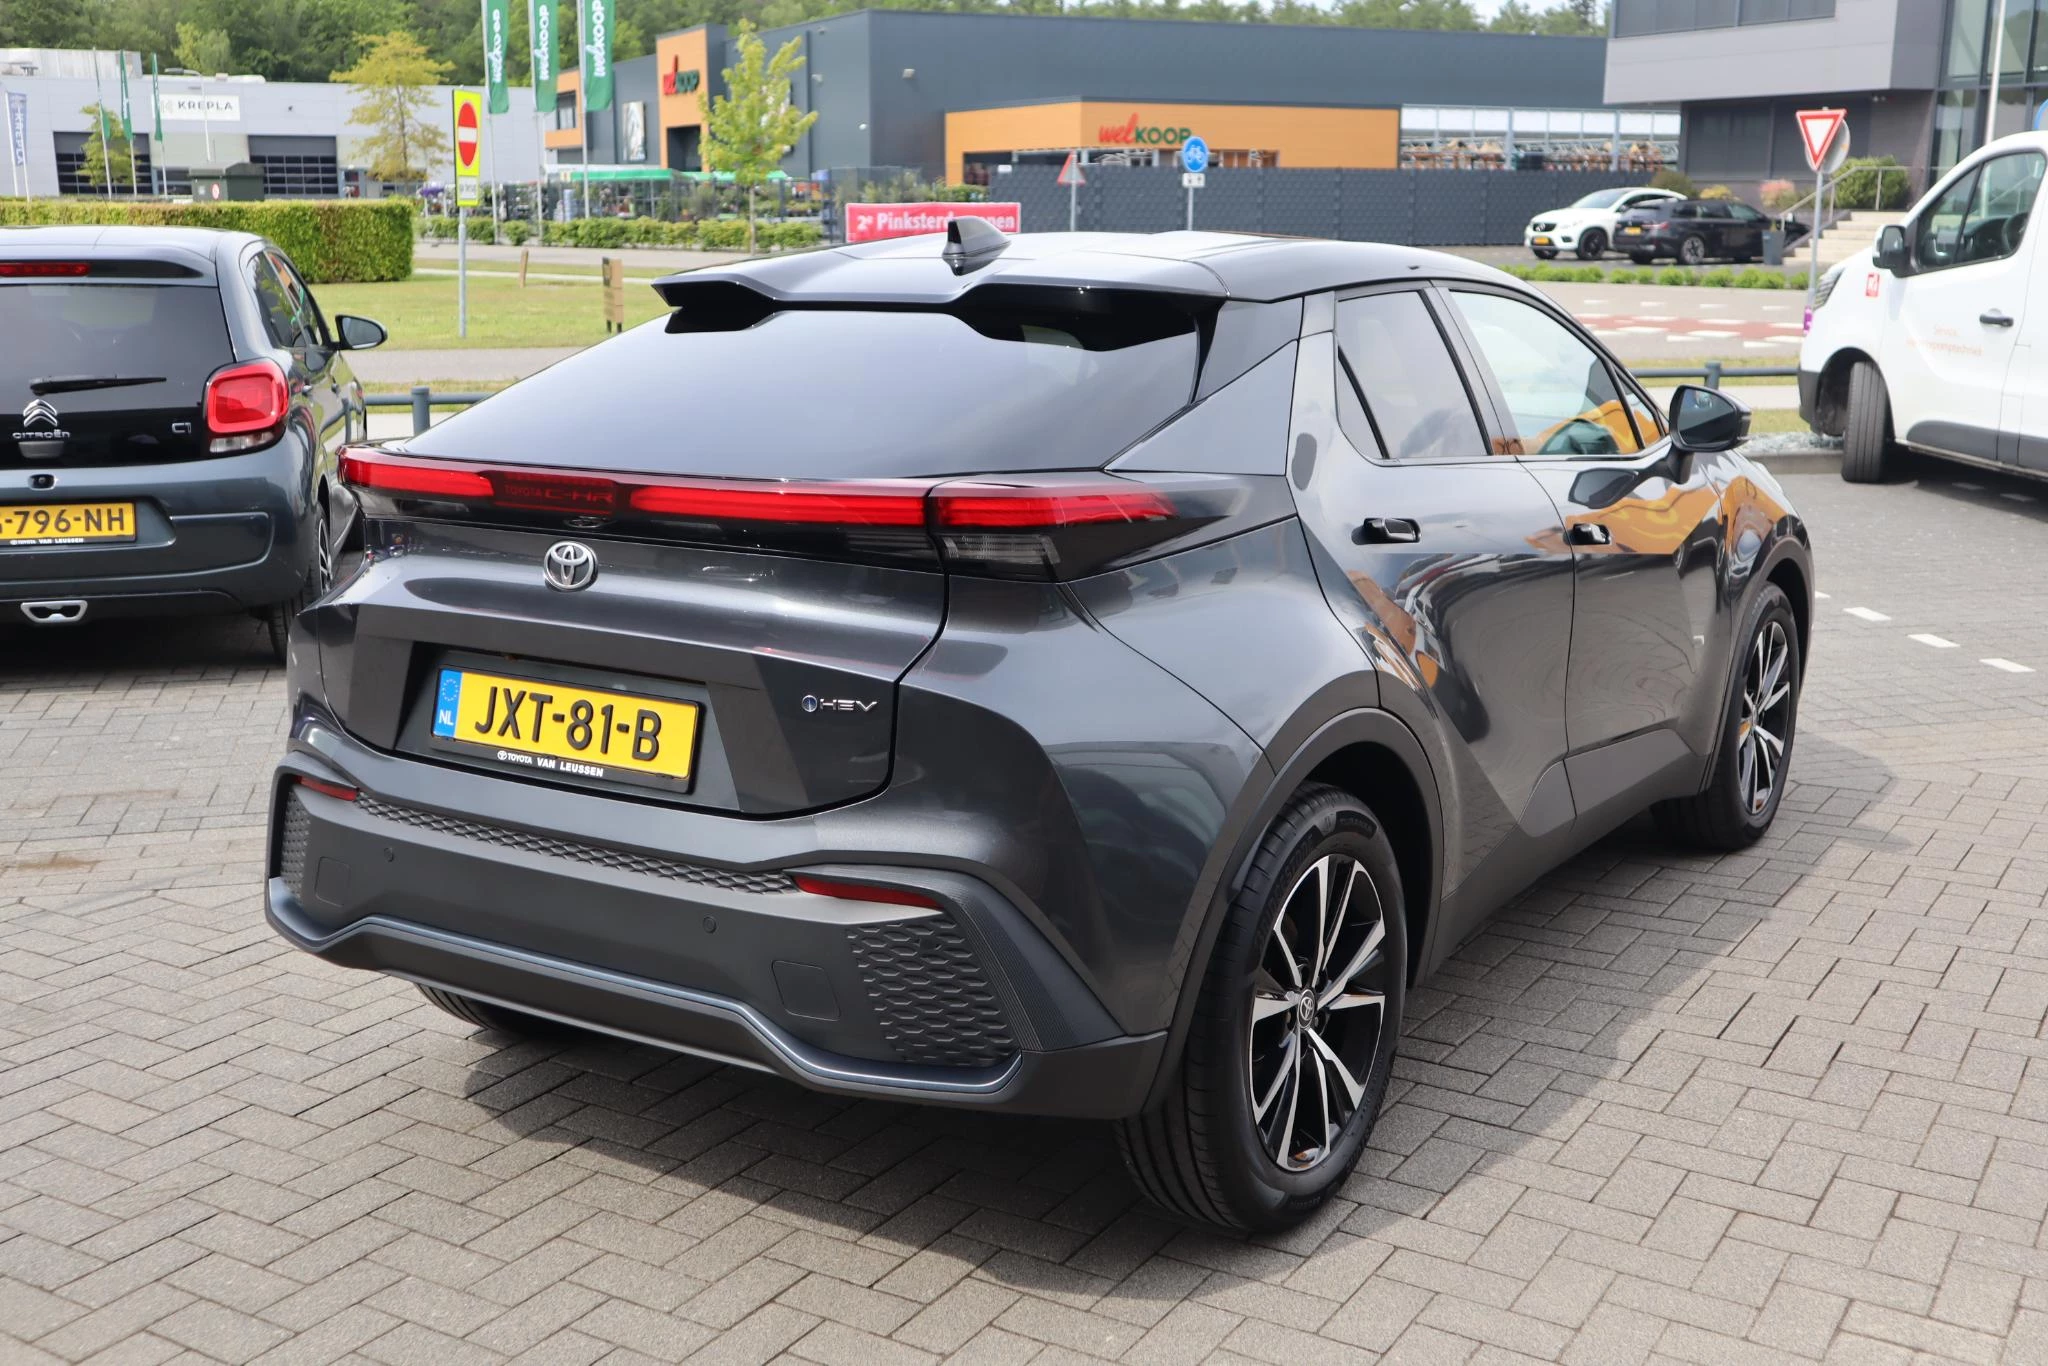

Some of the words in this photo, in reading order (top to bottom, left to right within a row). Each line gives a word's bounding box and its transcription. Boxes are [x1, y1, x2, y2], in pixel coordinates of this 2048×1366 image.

[0, 507, 125, 535] -796-NH
[438, 708, 454, 727] NL
[820, 698, 878, 712] HEV
[474, 686, 662, 762] JXT-81-B
[507, 752, 533, 765] TOYOTA
[537, 756, 556, 770] VAN
[560, 760, 604, 777] LEUSSEN
